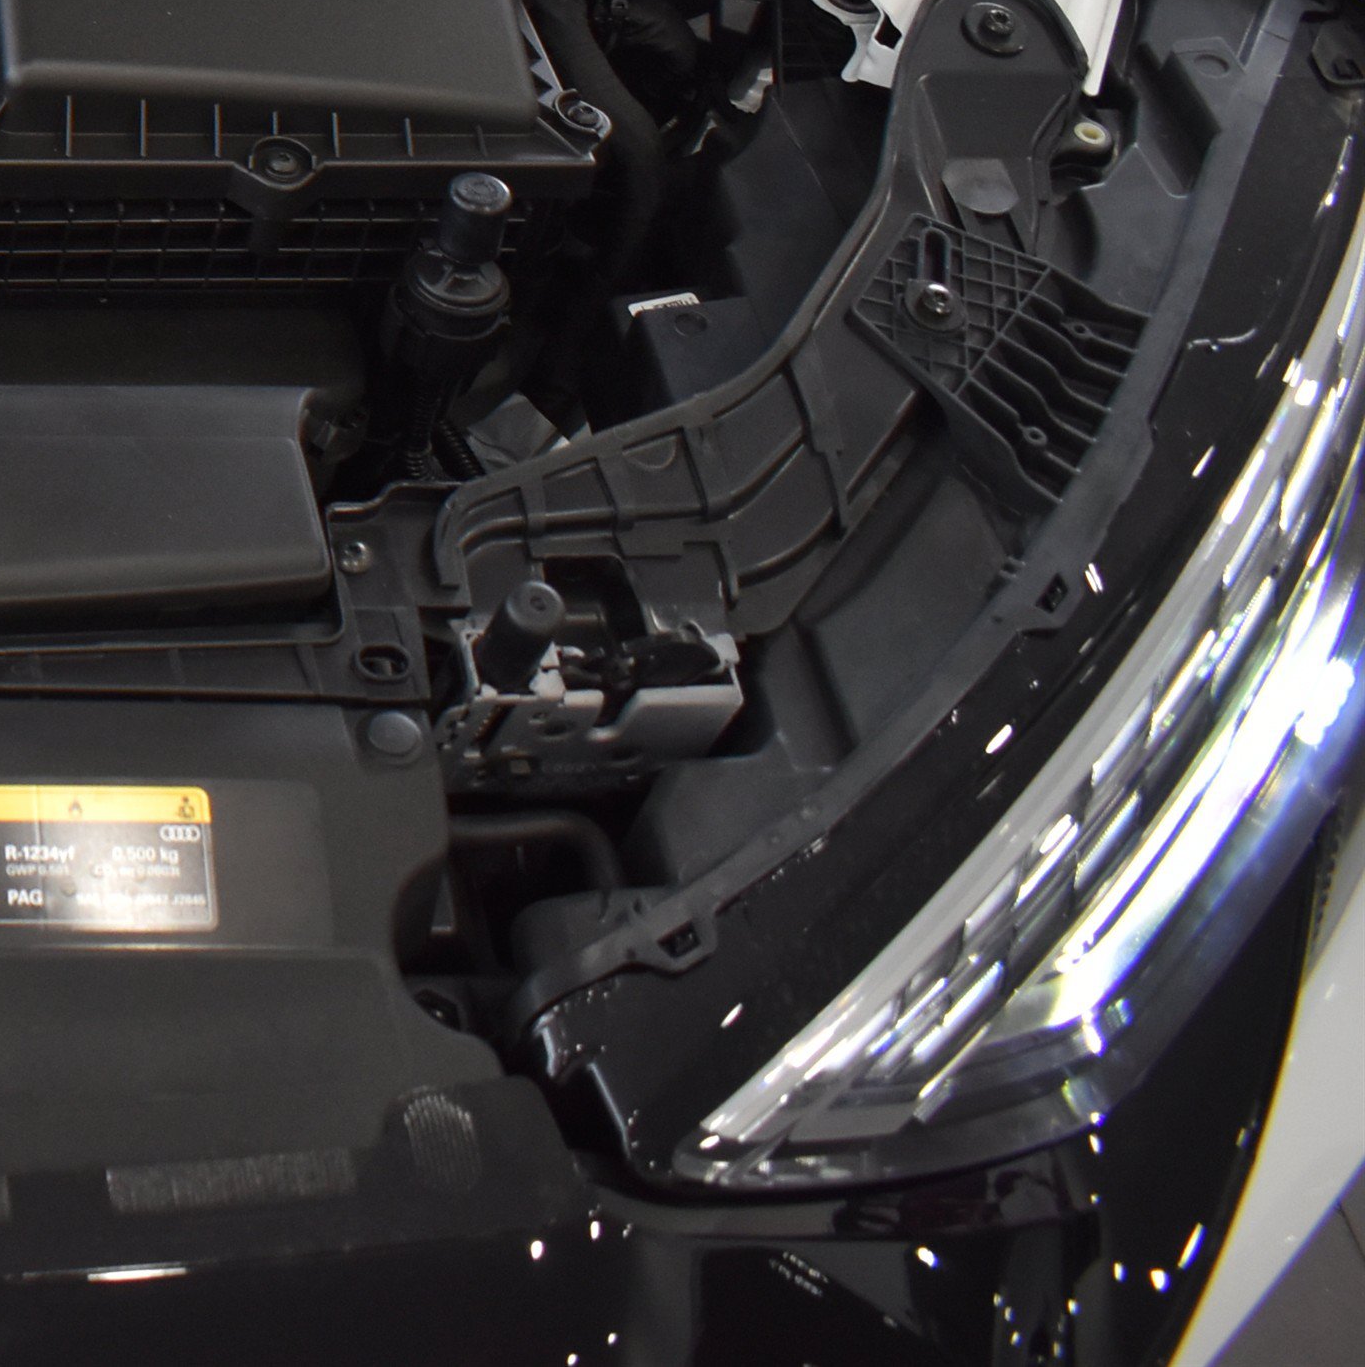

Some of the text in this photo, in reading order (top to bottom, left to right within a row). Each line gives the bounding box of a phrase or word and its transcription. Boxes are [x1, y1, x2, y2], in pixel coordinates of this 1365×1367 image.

[4, 844, 76, 864] R-1234yf
[159, 845, 180, 865] kg
[7, 888, 44, 907] PAG
